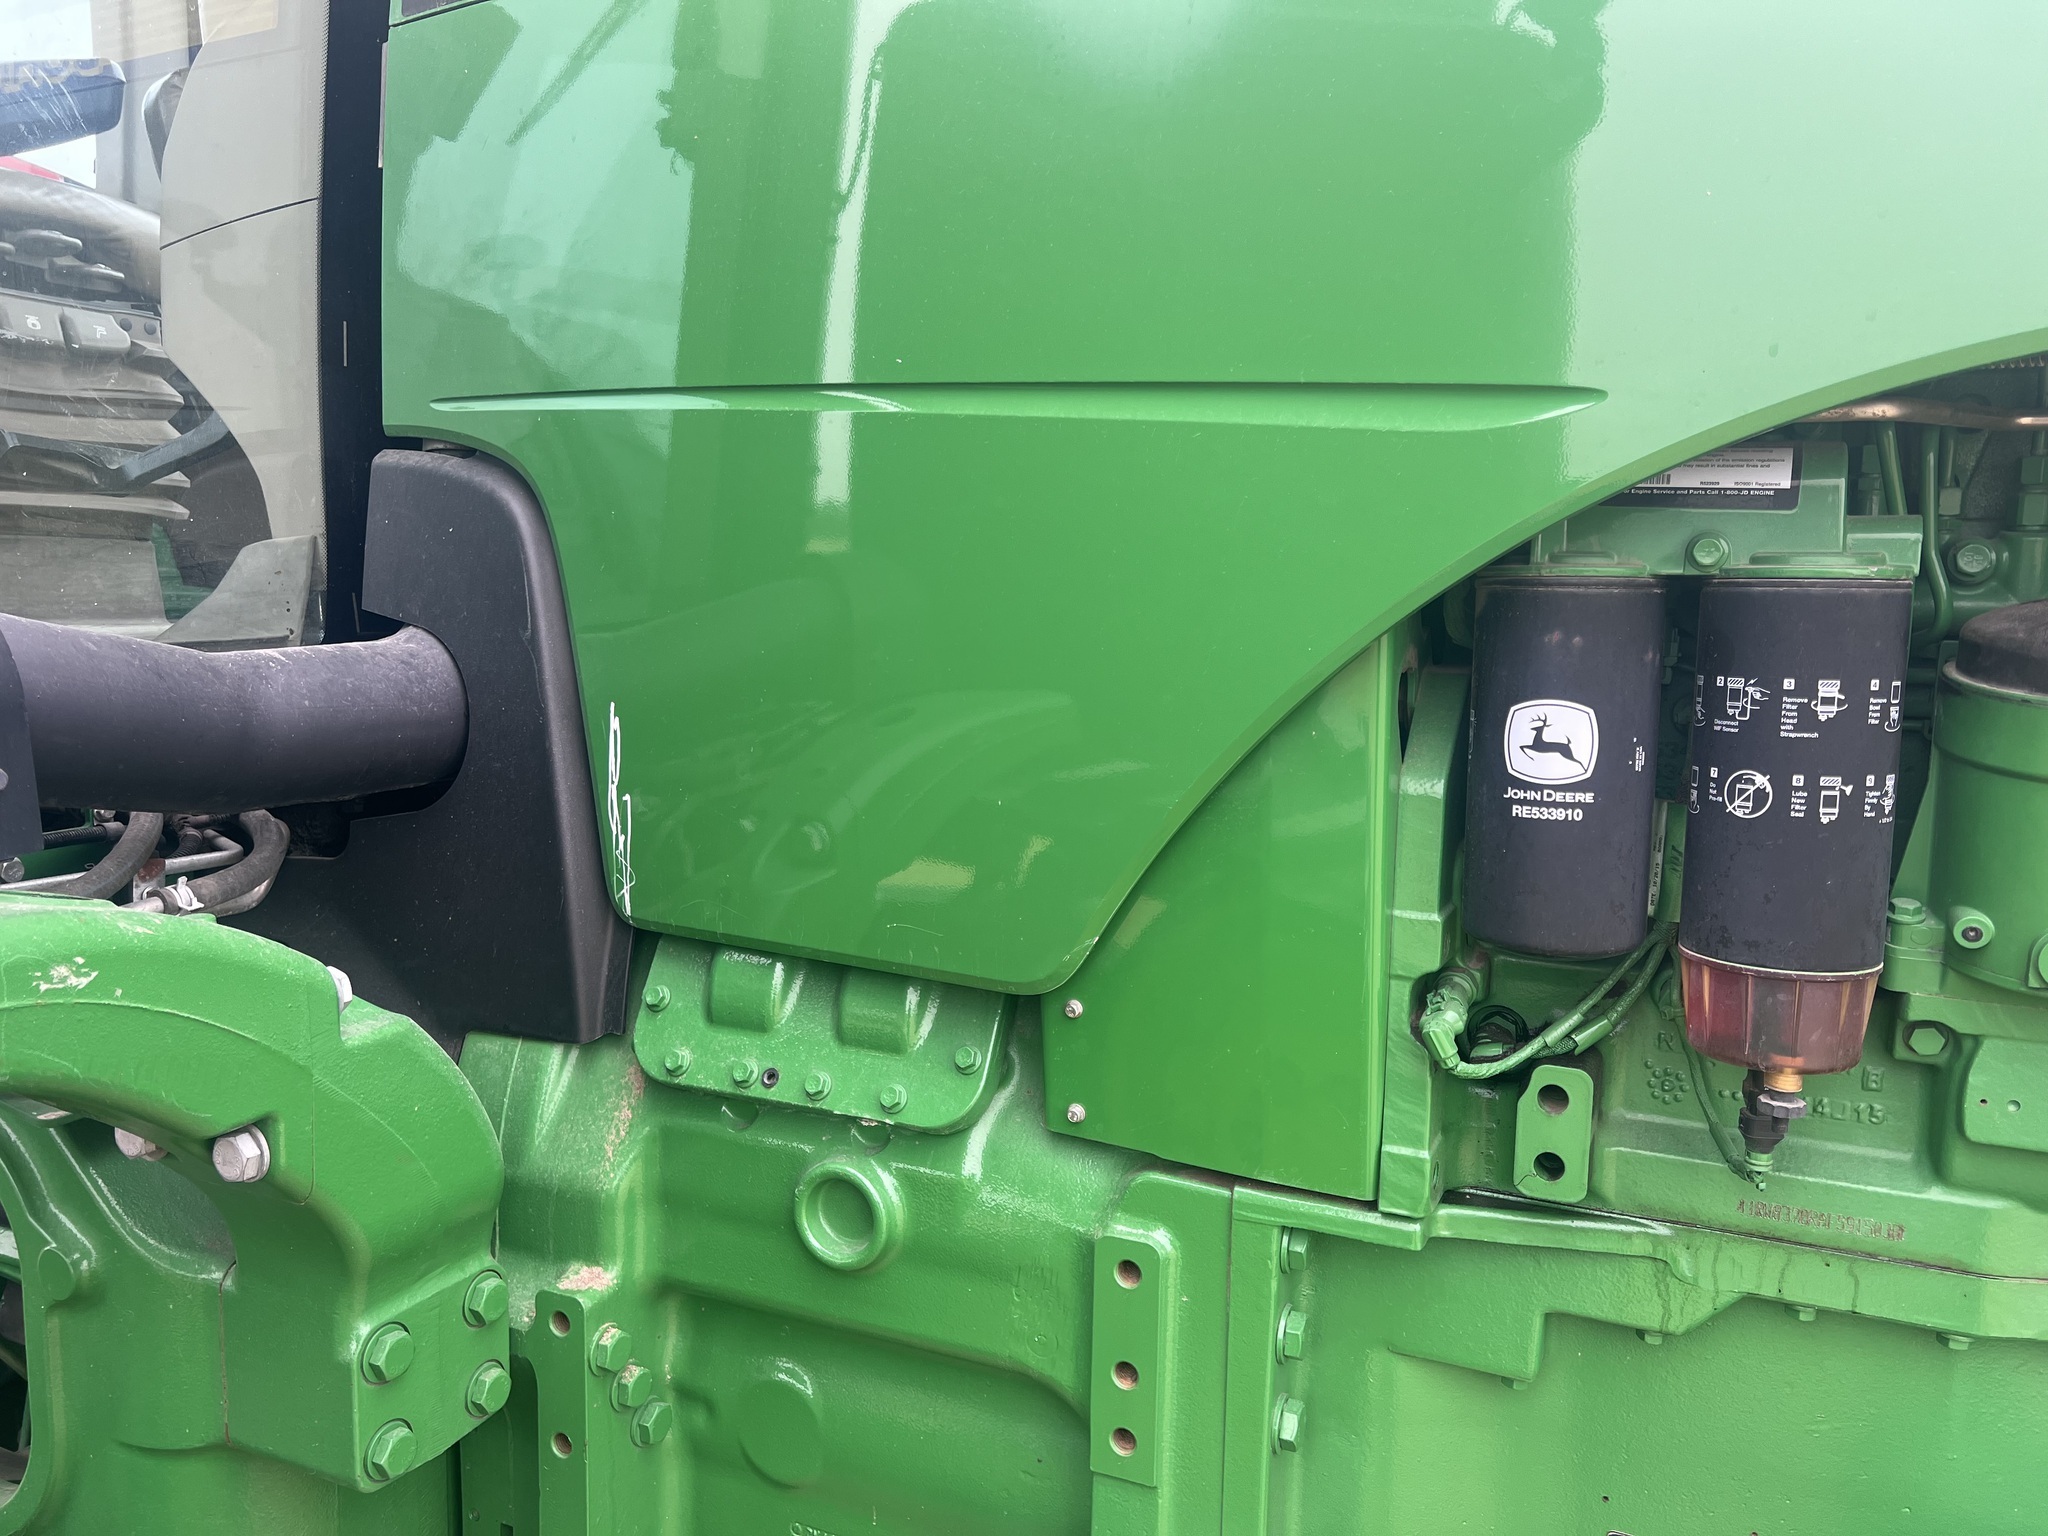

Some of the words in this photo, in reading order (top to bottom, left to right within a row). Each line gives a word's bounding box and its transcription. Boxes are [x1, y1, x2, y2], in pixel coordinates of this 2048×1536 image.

[1782, 696, 1809, 704] Remove
[1503, 786, 1541, 801] JOHN
[1543, 789, 1595, 803] DEERE
[1511, 805, 1584, 822] RE533910
